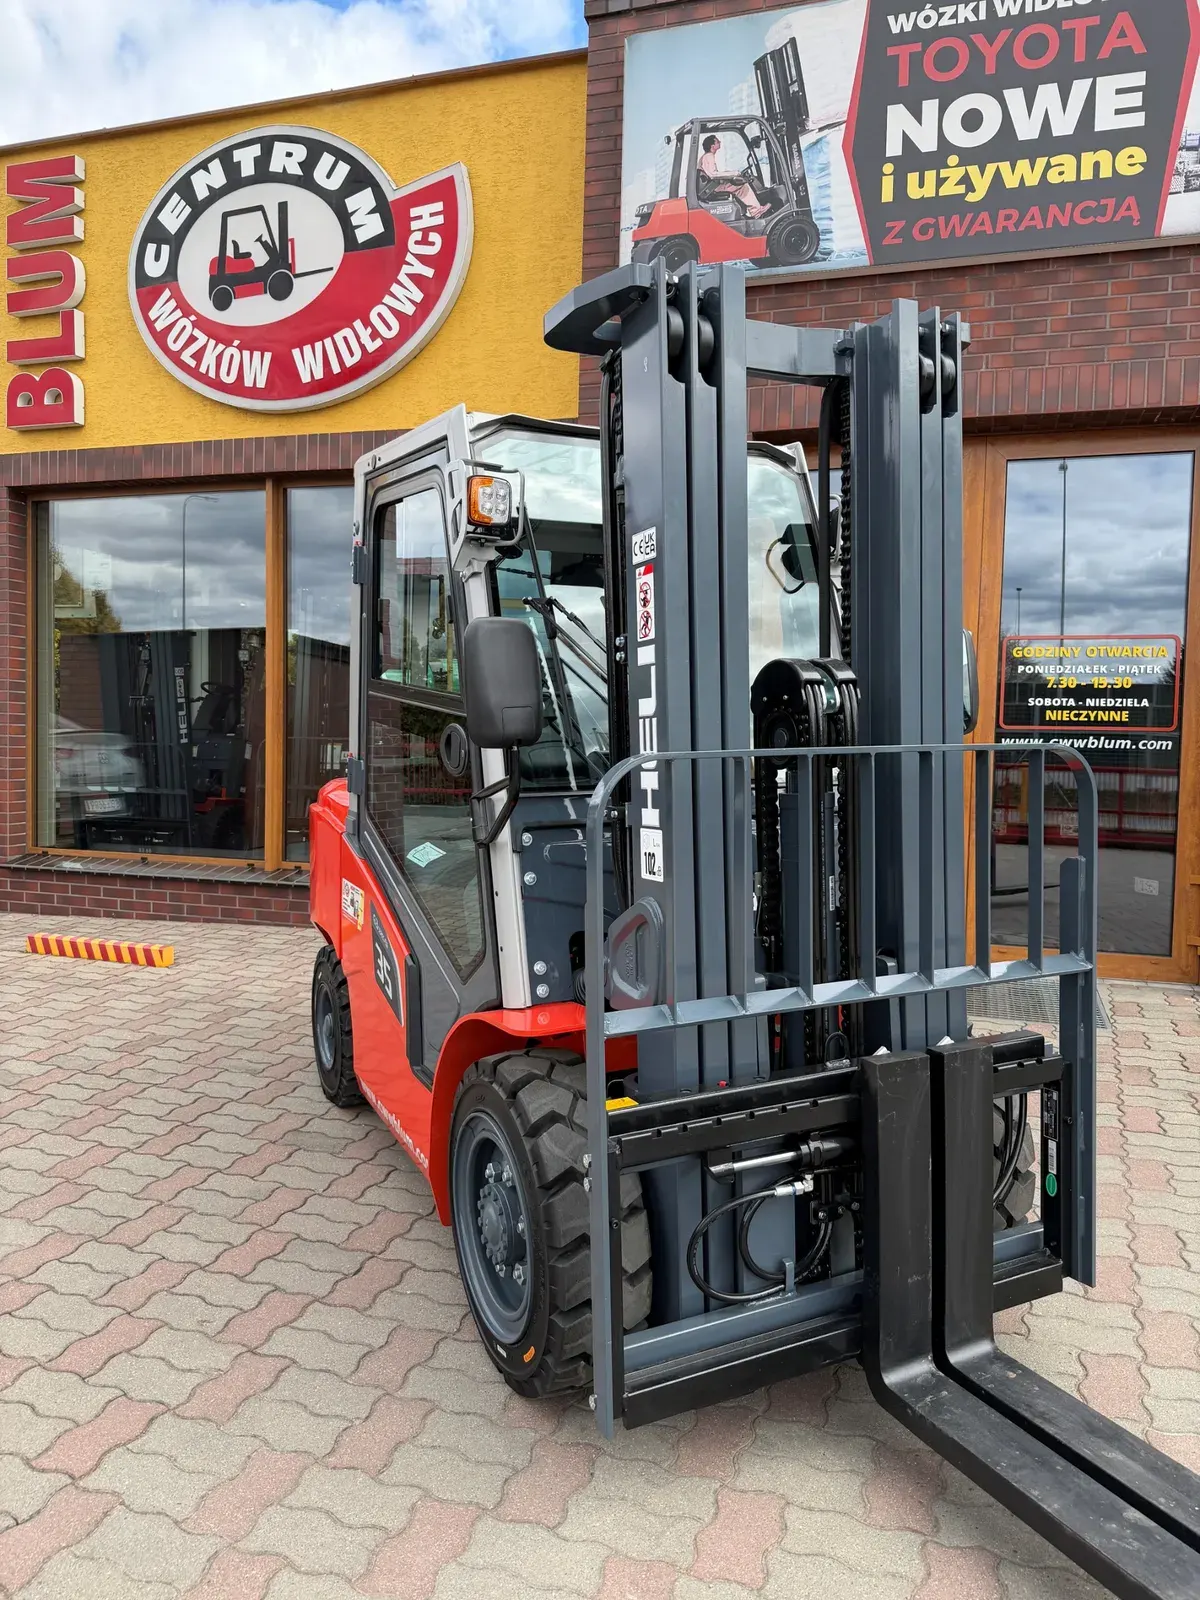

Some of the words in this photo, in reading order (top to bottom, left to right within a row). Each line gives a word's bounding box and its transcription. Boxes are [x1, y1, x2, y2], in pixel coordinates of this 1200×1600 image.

[886, 0, 986, 34] WÓZKI
[886, 11, 1148, 88] TOYOTA
[885, 70, 1147, 158] NOWE
[880, 162, 895, 203] i
[906, 145, 1148, 204] używane
[143, 140, 385, 279] CENTRUM
[911, 195, 1141, 243] GWARANCJĄ
[6, 154, 87, 431] BLUM
[147, 287, 273, 389] WÓZKÓW
[291, 201, 445, 385] WIDŁOWYCH
[1012, 646, 1081, 659] GODZINY
[1085, 645, 1169, 658] OTWARCIA
[1017, 665, 1108, 674] PONIEDZIAŁEK
[1118, 665, 1162, 676] PIĄTEK
[1027, 697, 1076, 708] SOBOTA
[1085, 697, 1150, 708] NIEDZIELA
[1046, 676, 1077, 689] 7.30
[1092, 676, 1133, 689] 15.30
[177, 697, 188, 744] HELI
[636, 643, 660, 828] HELI
[1045, 709, 1130, 722] NIECZYNNE
[1001, 736, 1173, 751] wwwcwwblum.com
[644, 851, 656, 876] 102
[374, 942, 394, 1001] 35
